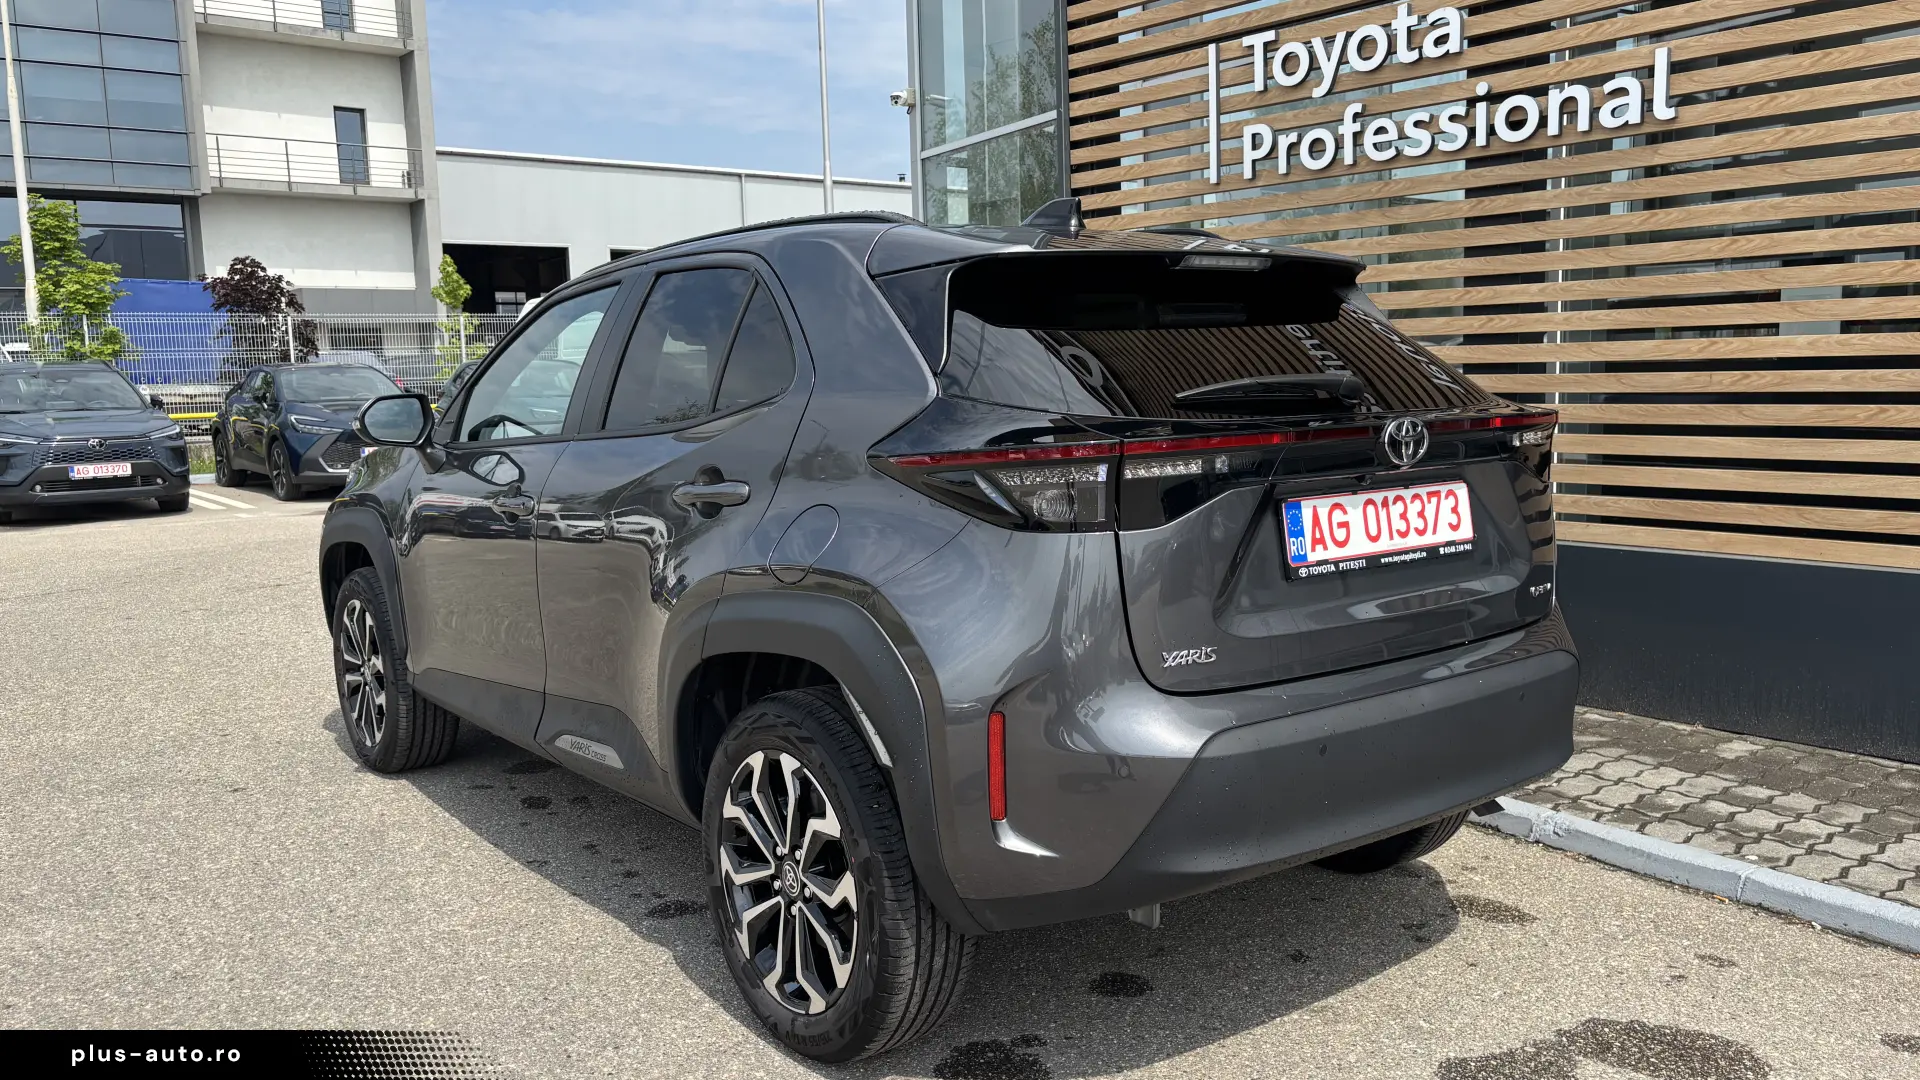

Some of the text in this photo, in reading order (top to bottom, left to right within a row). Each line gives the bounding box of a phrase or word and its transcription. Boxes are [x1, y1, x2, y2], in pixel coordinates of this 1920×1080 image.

[1242, 2, 1464, 98] Toyota
[1243, 47, 1676, 180] Professional
[76, 466, 89, 475] AG
[93, 464, 128, 474] 013370
[1311, 488, 1462, 553] AG 013373
[1290, 536, 1306, 557] RO
[1309, 564, 1336, 575] TOYOTA
[591, 750, 607, 762] CROSS
